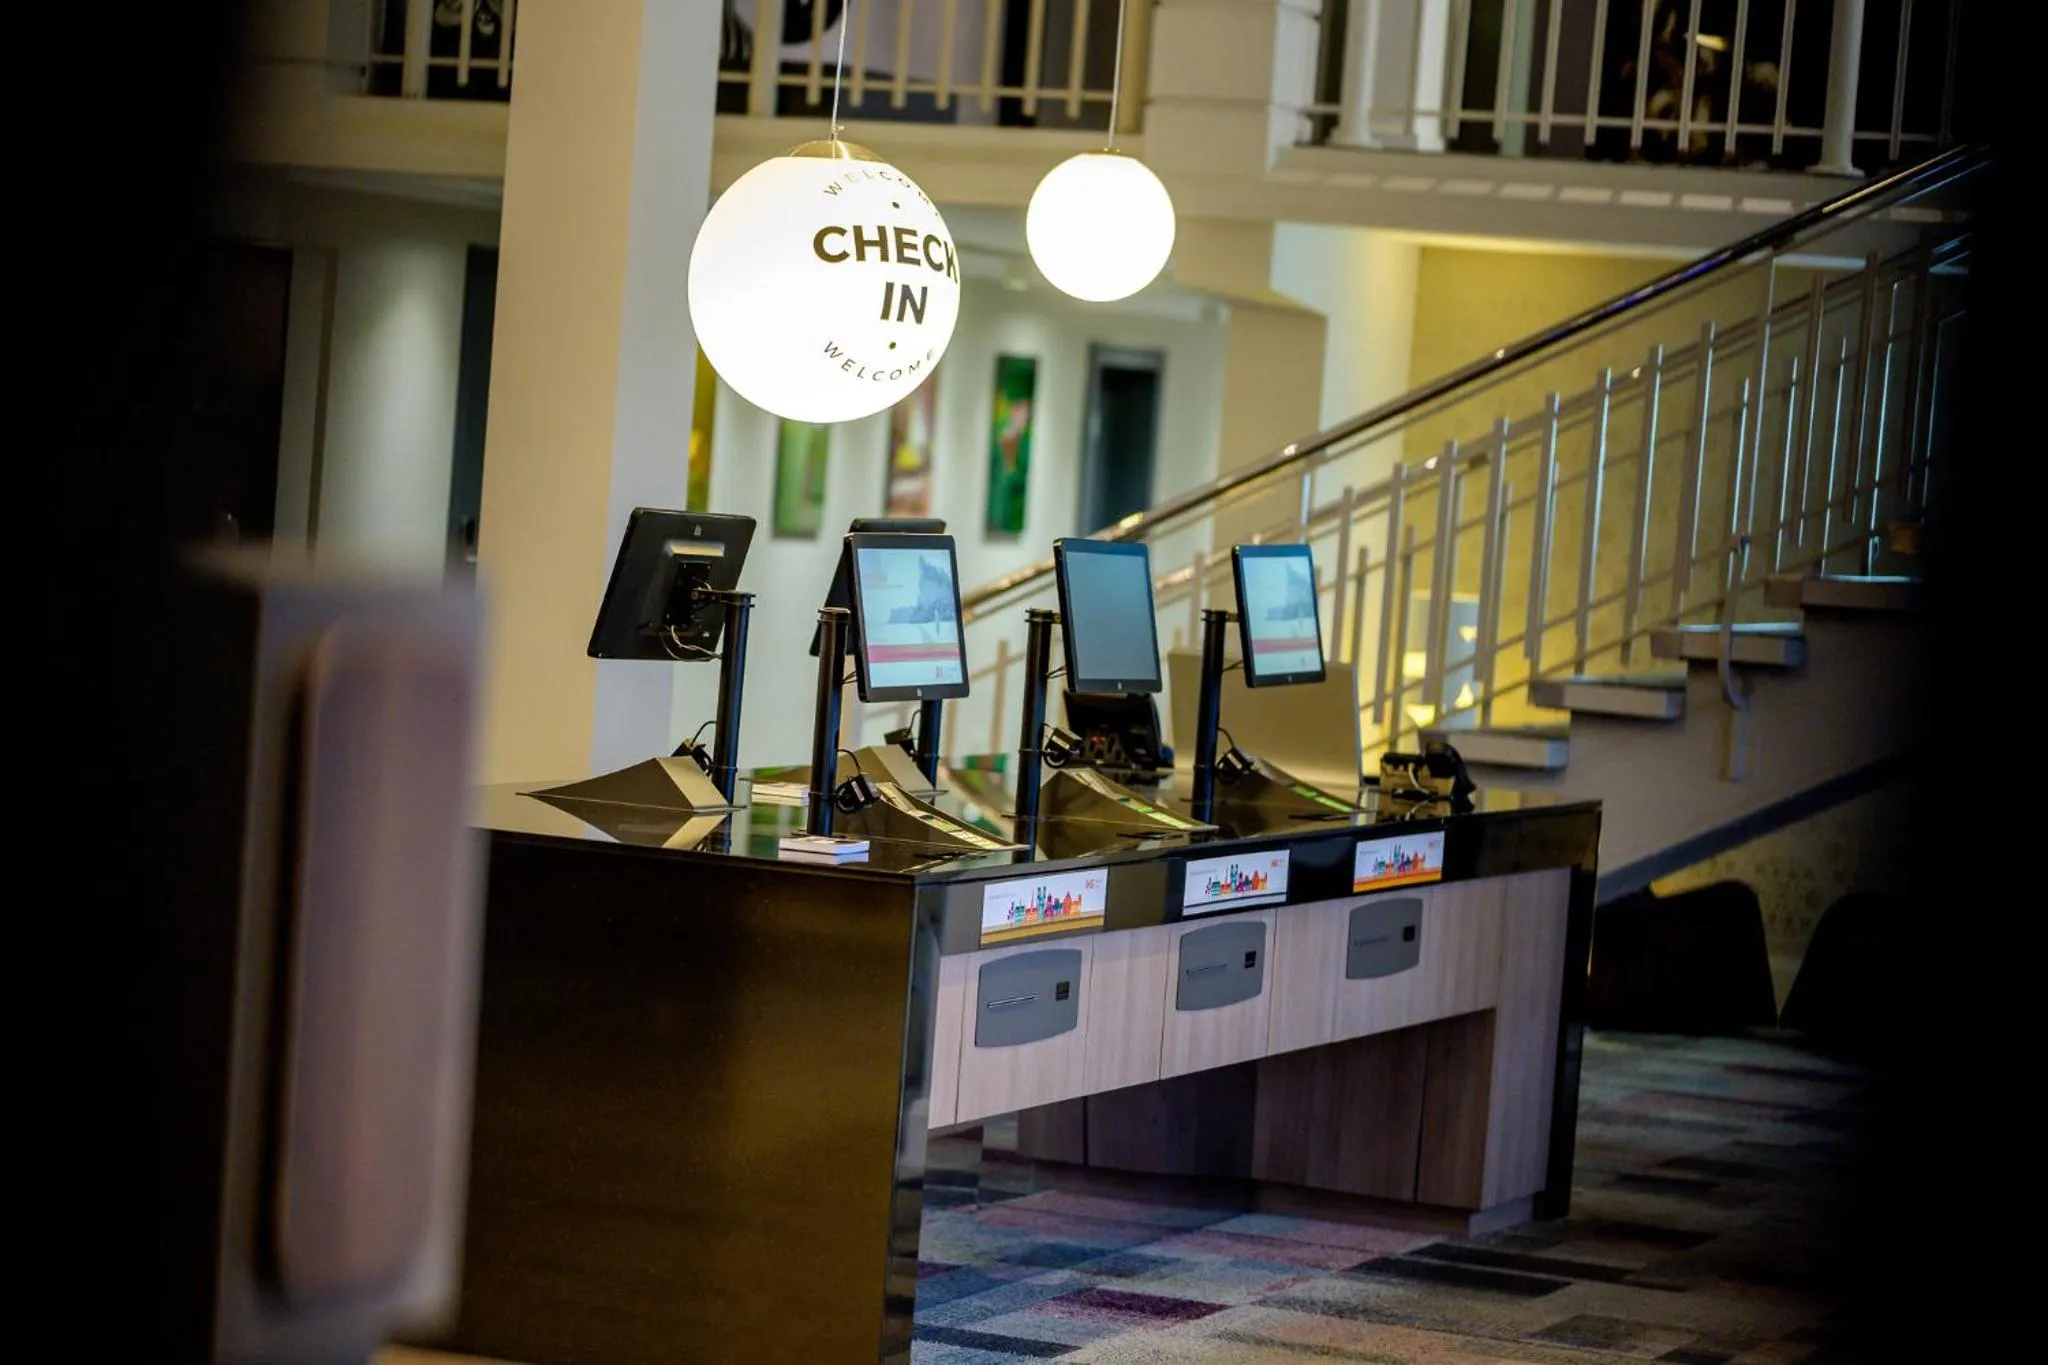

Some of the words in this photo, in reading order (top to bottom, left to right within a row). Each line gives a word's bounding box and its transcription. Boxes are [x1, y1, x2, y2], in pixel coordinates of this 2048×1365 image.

[823, 169, 939, 216] WELCO
[813, 225, 958, 284] CHECK
[880, 281, 928, 325] IN
